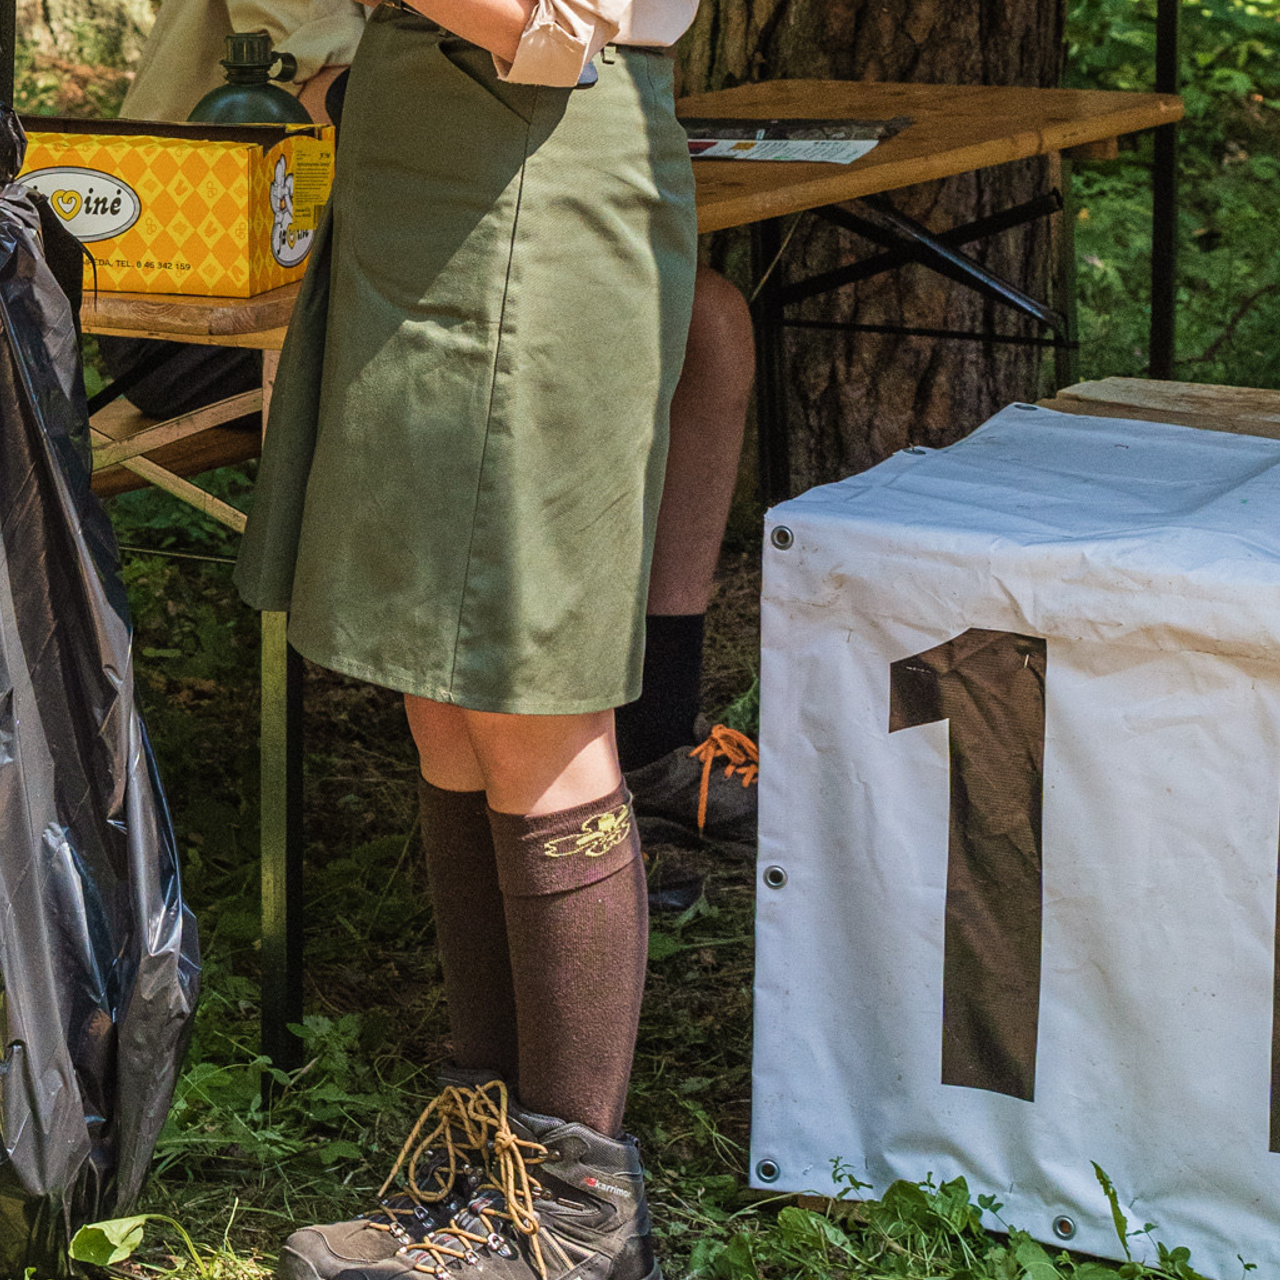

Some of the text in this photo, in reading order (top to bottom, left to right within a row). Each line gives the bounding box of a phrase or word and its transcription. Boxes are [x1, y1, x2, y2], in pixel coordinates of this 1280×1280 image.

[116, 260, 134, 268] TEL.
[157, 261, 173, 270] 342
[175, 262, 191, 271] 159
[889, 627, 1047, 1103] 1
